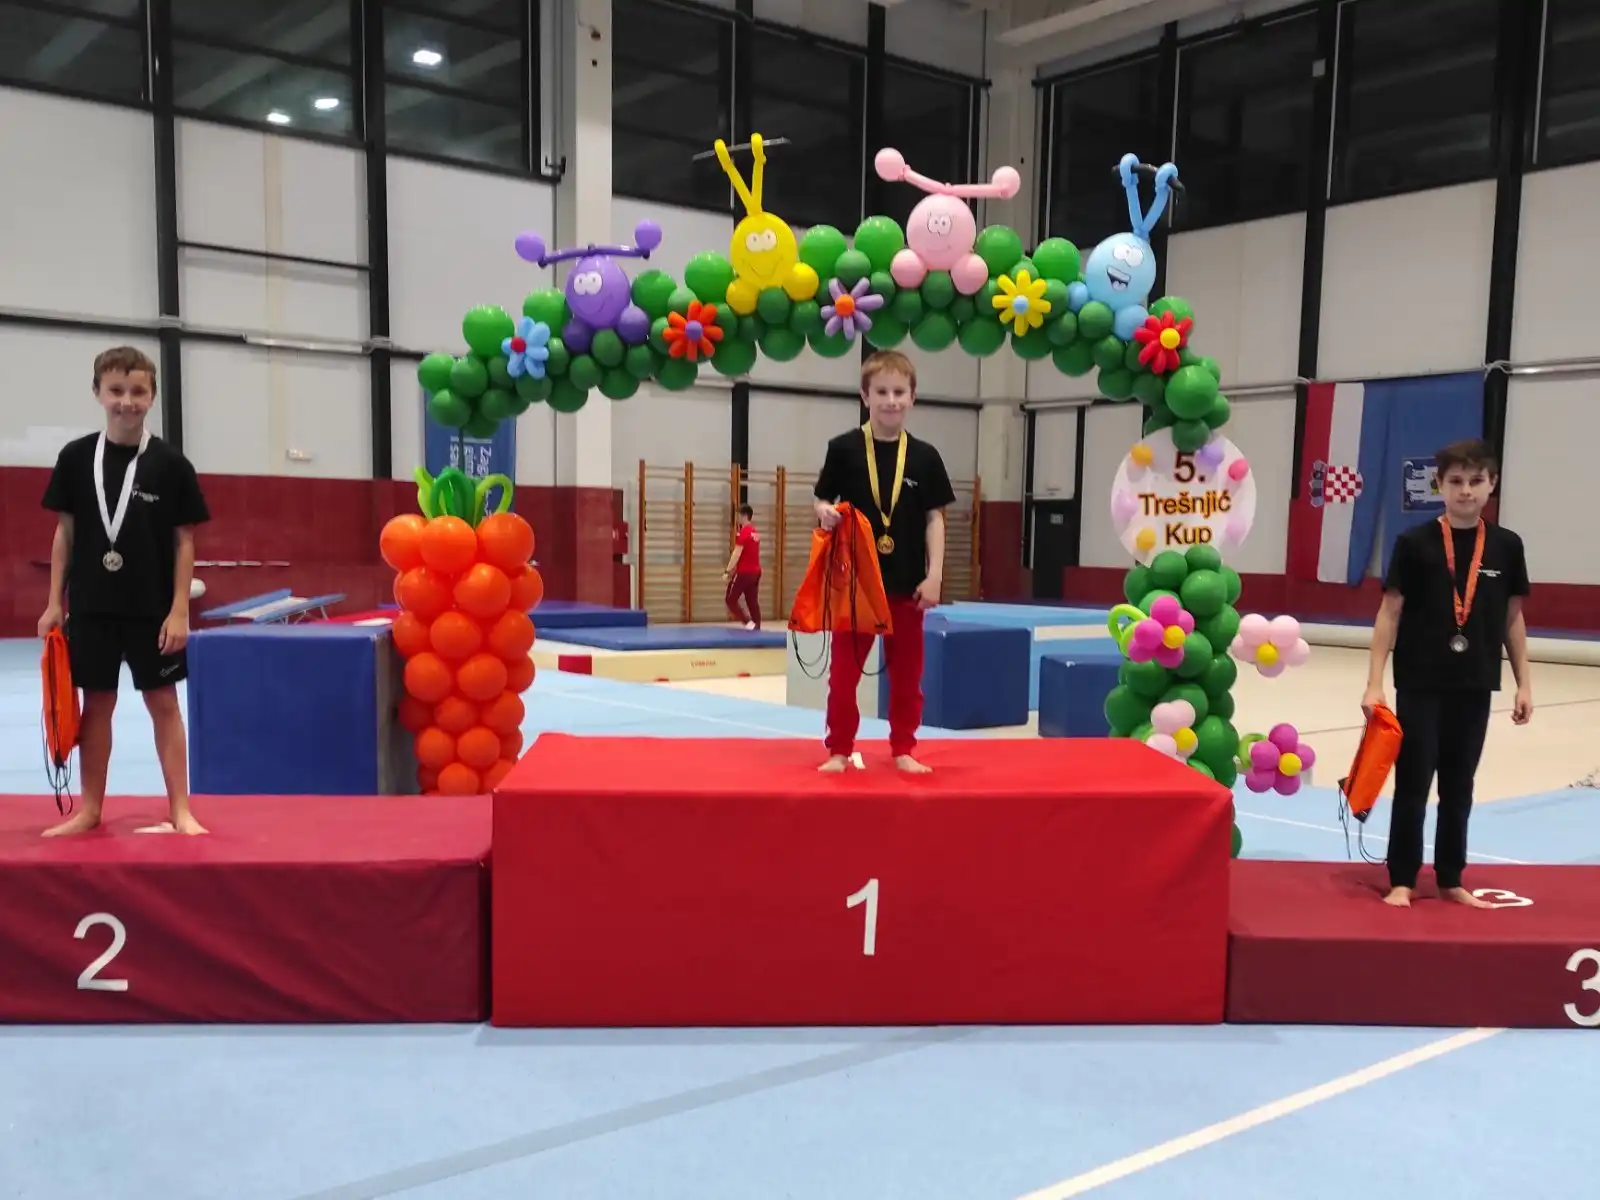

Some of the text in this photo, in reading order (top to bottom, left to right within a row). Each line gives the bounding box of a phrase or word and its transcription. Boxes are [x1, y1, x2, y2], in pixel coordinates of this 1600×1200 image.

[1174, 451, 1205, 483] 5.
[1138, 489, 1231, 519] Trešnjić
[1165, 523, 1212, 545] Kup
[846, 878, 879, 956] 1
[73, 912, 128, 992] 2
[1563, 948, 1600, 1026] 3
